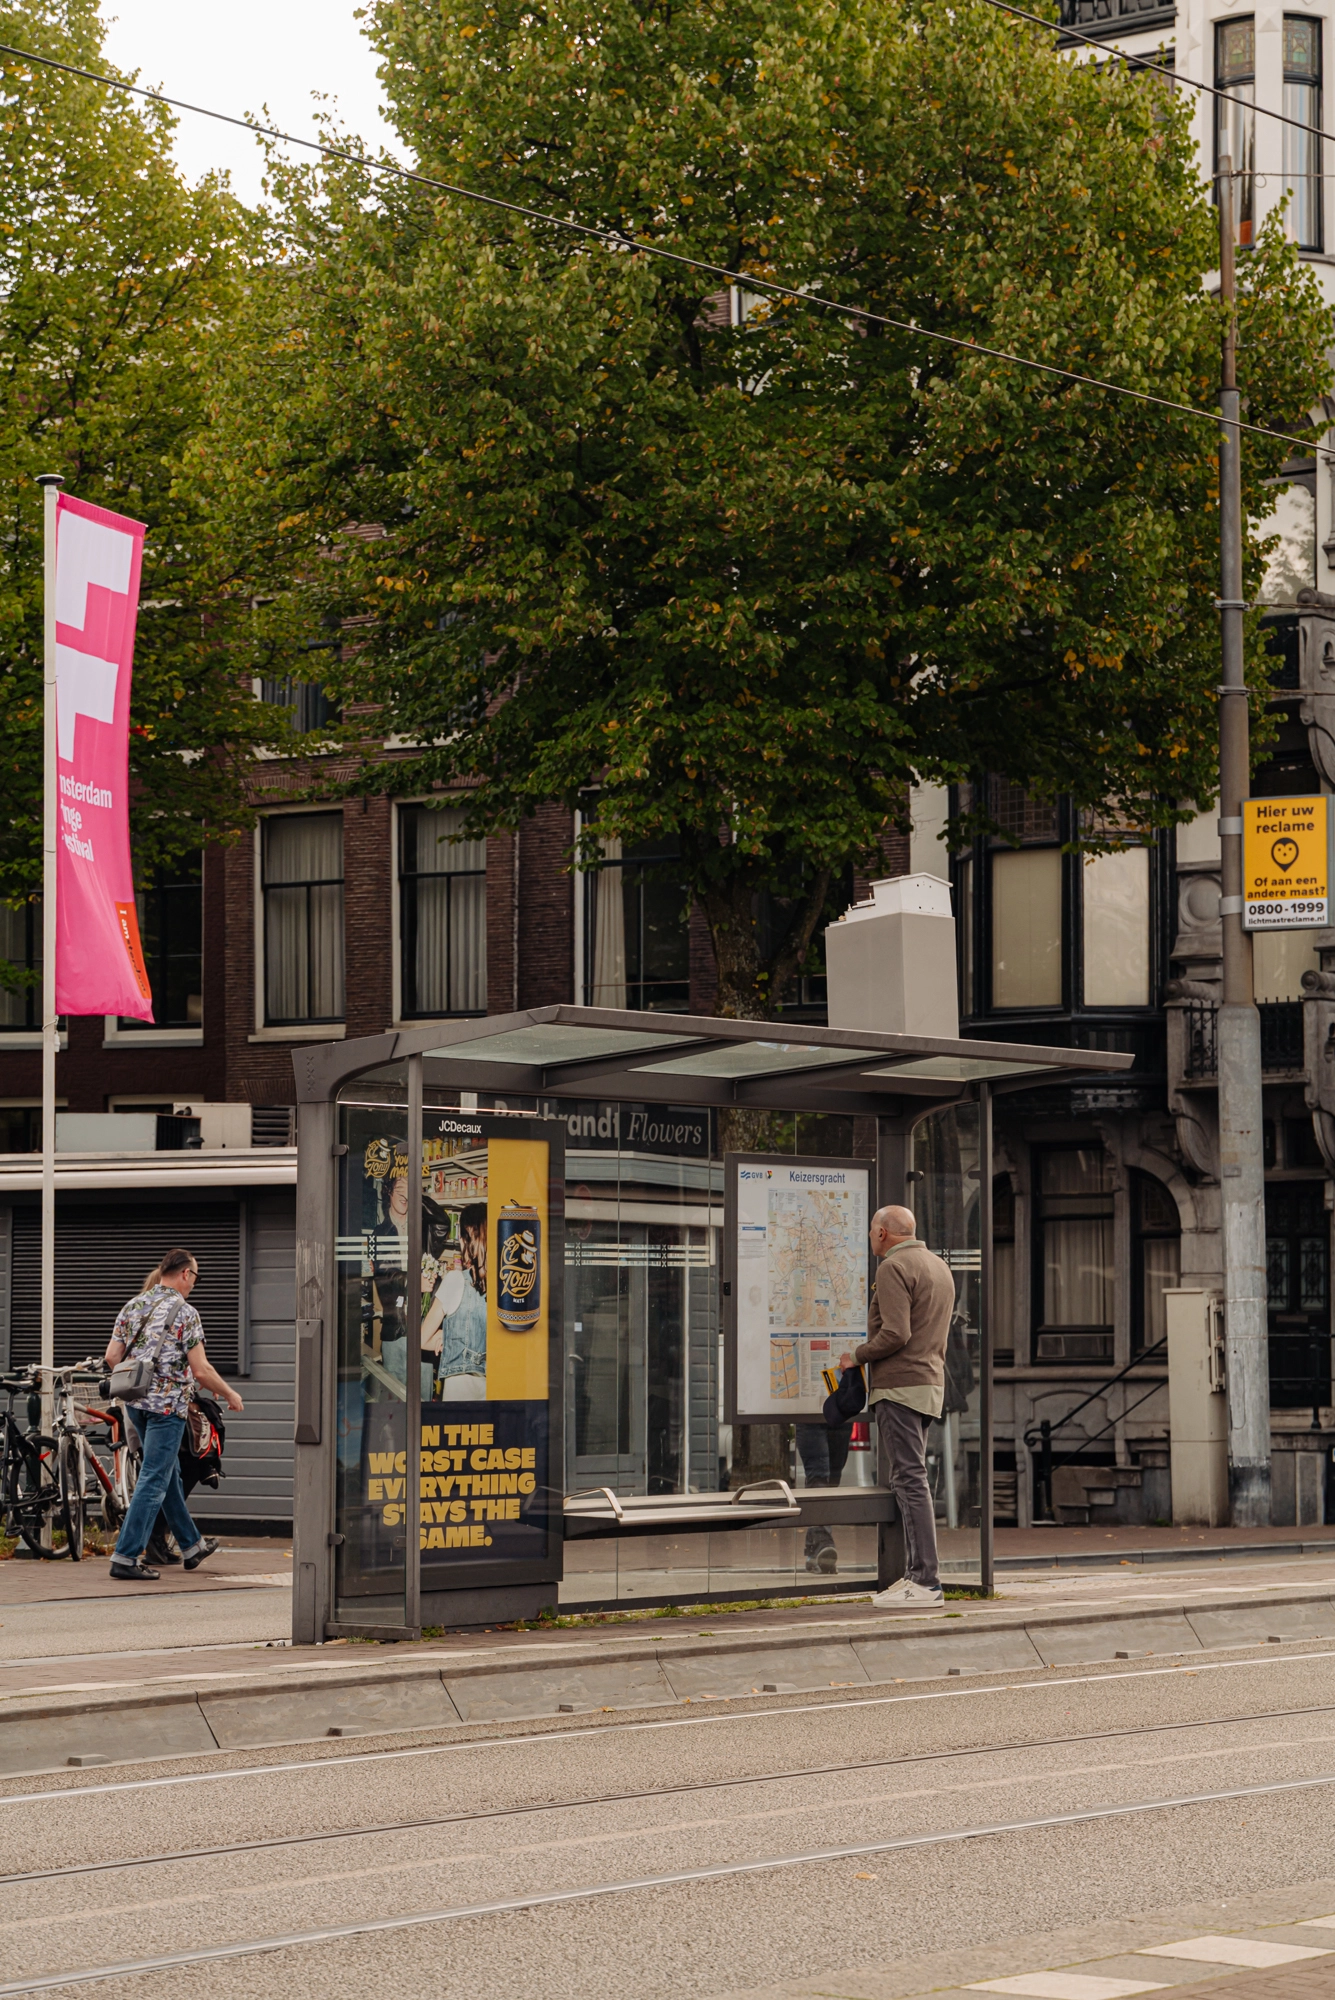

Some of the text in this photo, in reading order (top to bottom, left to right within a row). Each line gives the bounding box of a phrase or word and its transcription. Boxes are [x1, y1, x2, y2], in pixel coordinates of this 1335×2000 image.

[1257, 805, 1314, 818] Hier uw
[1256, 821, 1315, 834] reclame
[62, 826, 94, 862] estival
[1254, 877, 1317, 887] Of aan een
[1247, 886, 1326, 899] andere mast?
[1248, 915, 1326, 925] lichtmastreclame.nl
[438, 1120, 482, 1134] JCDecaux
[626, 1112, 702, 1145] Flowers
[751, 1171, 846, 1186] GVB Keizersgracht
[499, 1264, 536, 1297] Tony
[421, 1423, 494, 1447] N THE
[470, 1447, 536, 1471] CASE
[368, 1472, 536, 1500] EVRYTHING
[470, 1498, 520, 1521] THE
